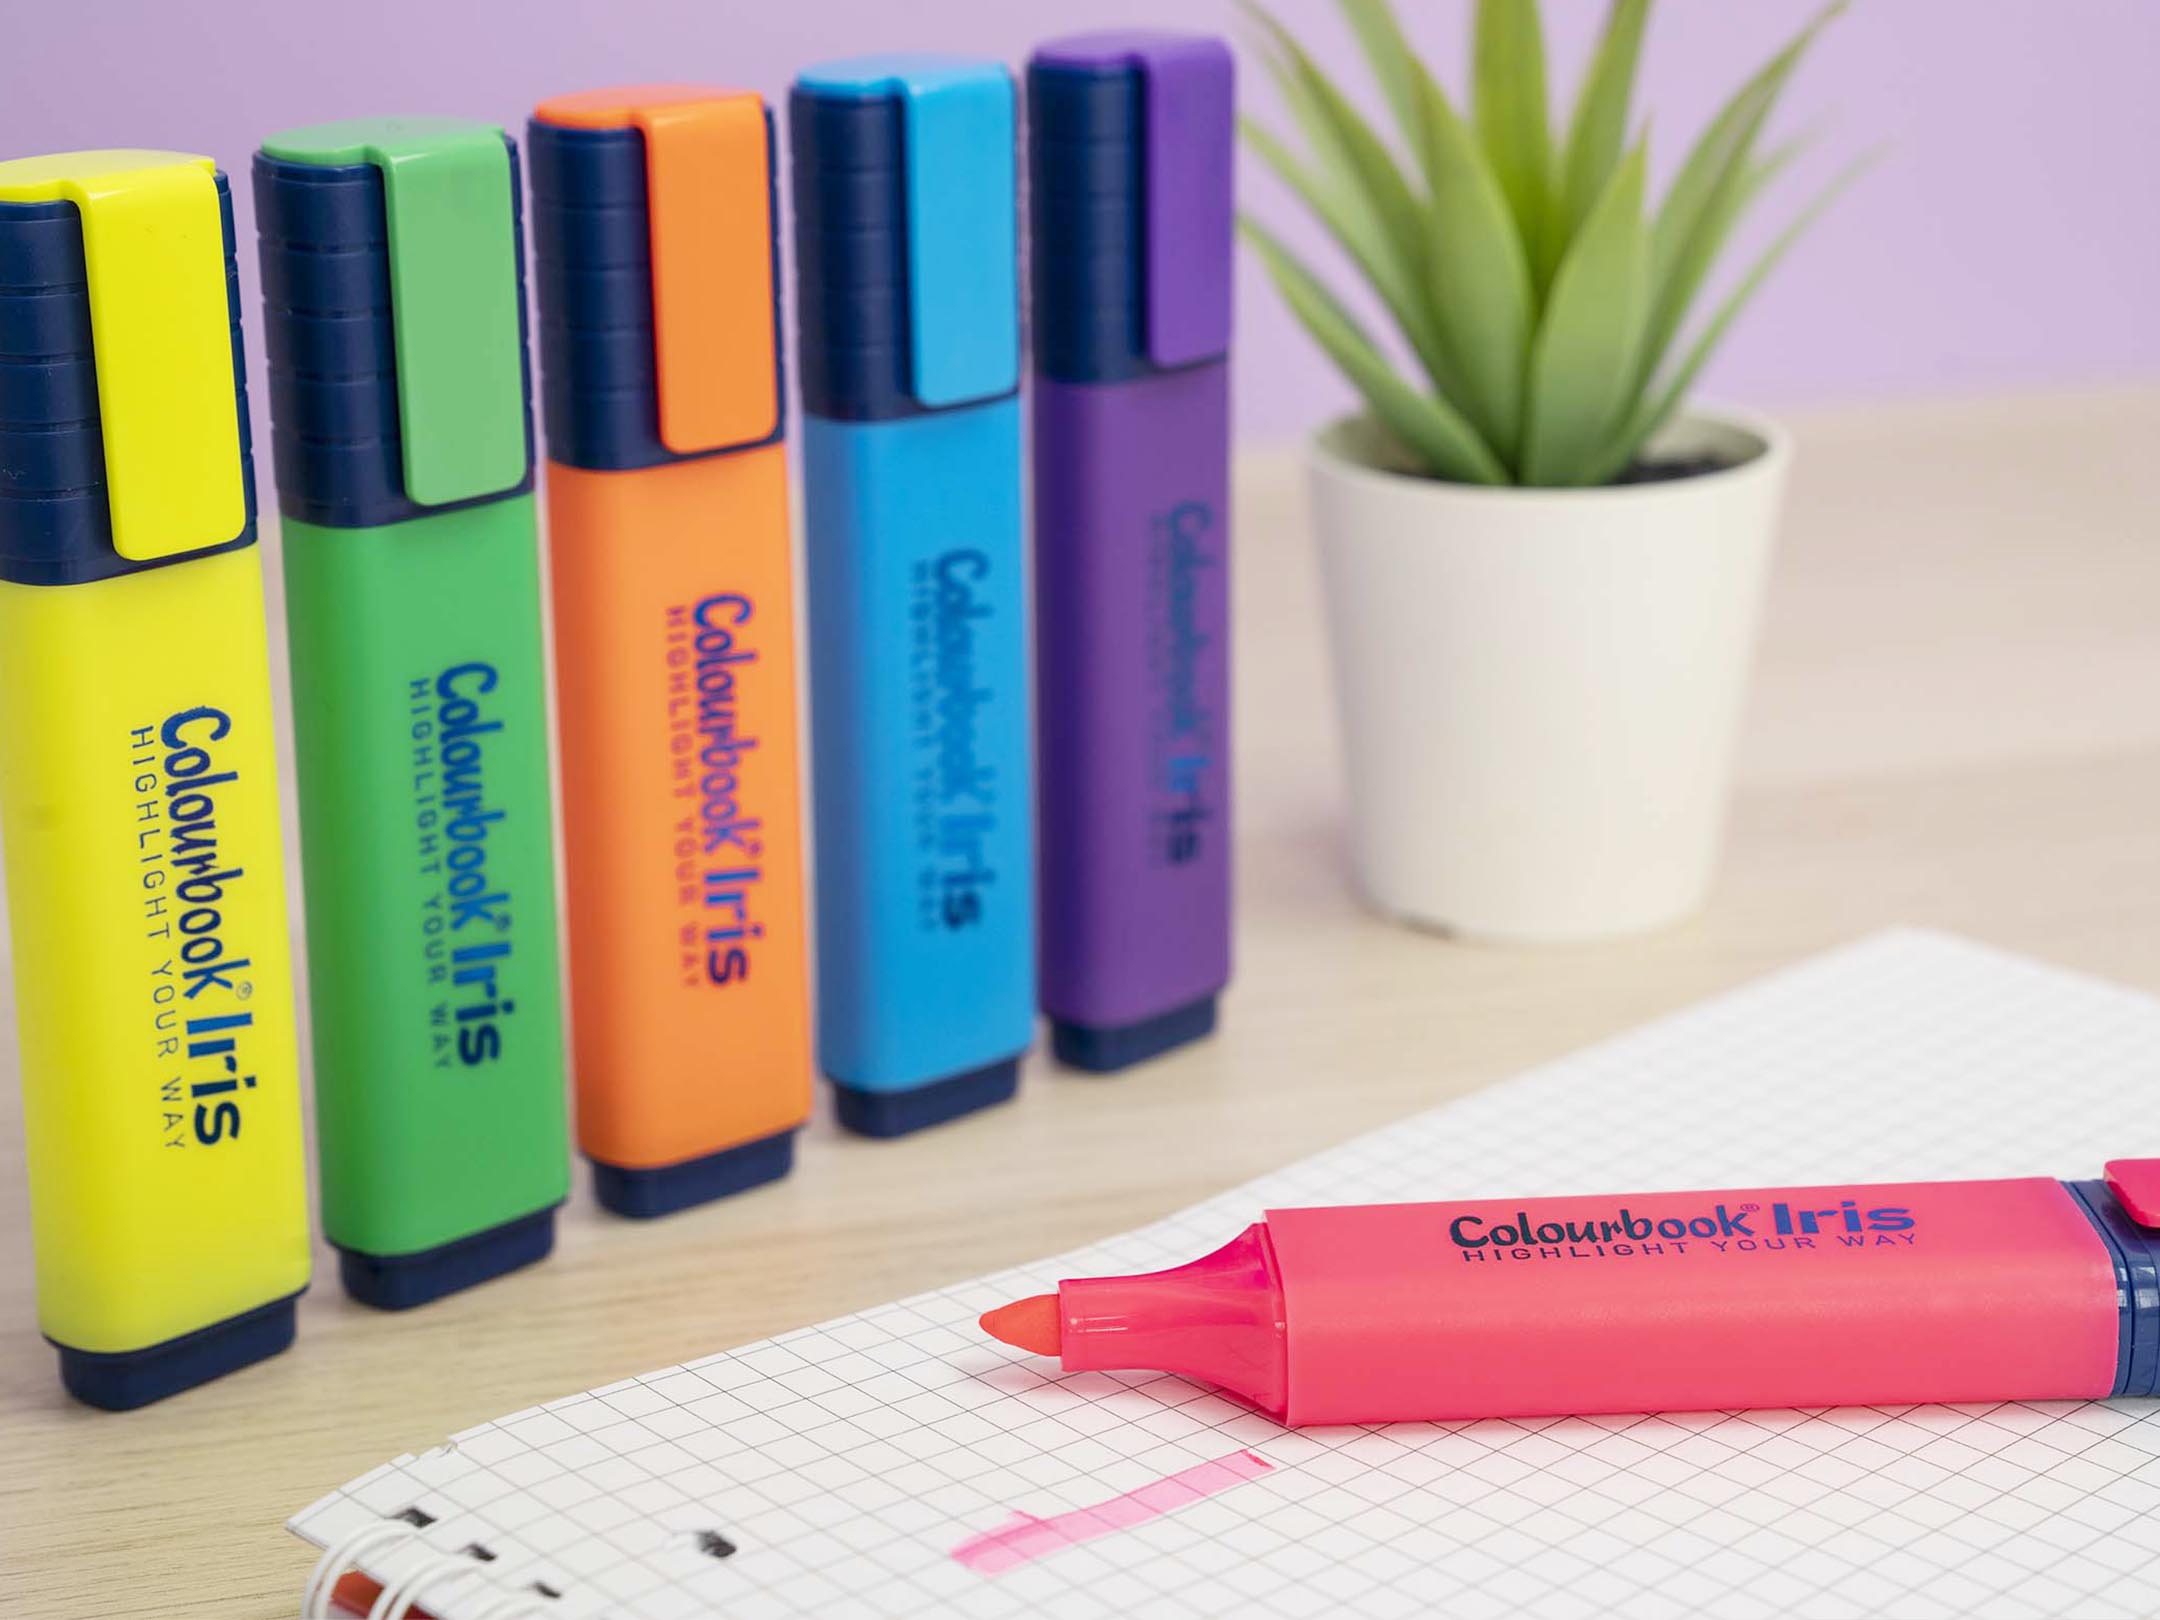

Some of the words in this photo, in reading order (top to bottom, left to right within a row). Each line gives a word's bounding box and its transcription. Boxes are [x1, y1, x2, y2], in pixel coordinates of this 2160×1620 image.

[665, 605, 698, 798] HIGHLIGHT
[409, 677, 441, 876] HIGHLIGHT
[131, 725, 170, 938] HIGHLIGHT
[674, 817, 698, 905] YOUR
[422, 893, 447, 985] YOUR
[704, 868, 765, 986] Iris
[151, 959, 179, 1057] YOUR
[429, 1001, 453, 1070] WAY
[452, 941, 515, 1066] Iris
[161, 1076, 186, 1149] WAY
[186, 1011, 257, 1145] Iris
[1462, 1242, 1688, 1262] HIGHLIGHT
[1711, 1236, 1816, 1252] YOUR
[1836, 1232, 1917, 1248] WAY
[1773, 1201, 1916, 1235] Iris
